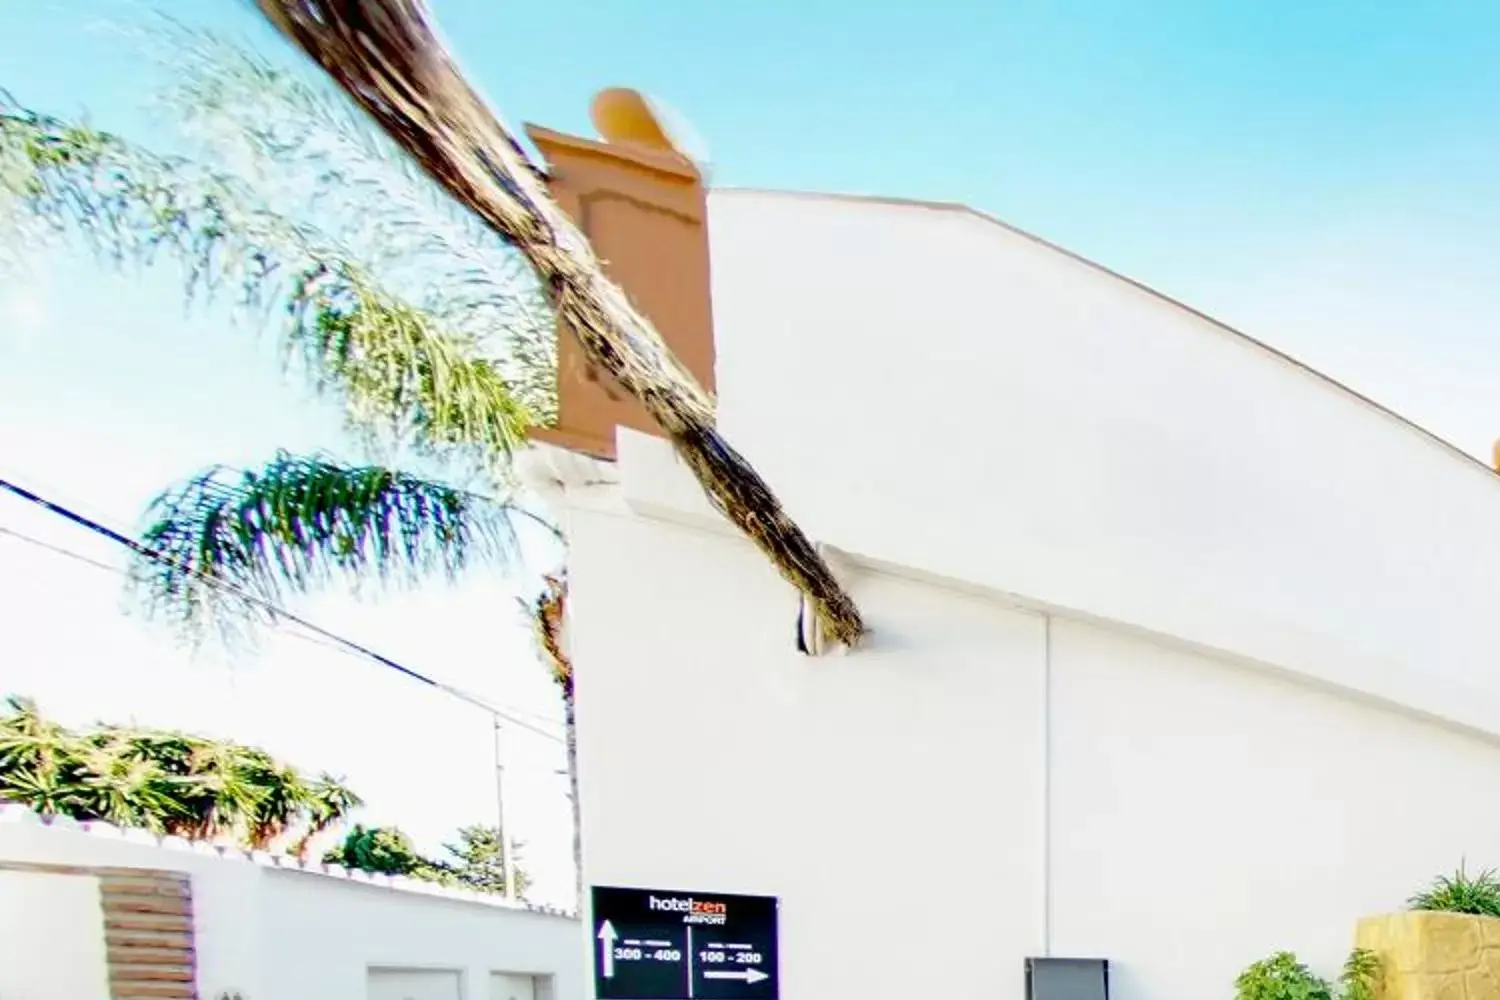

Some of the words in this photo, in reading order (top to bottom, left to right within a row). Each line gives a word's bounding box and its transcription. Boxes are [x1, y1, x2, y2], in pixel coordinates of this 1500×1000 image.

[614, 948, 641, 960] 300
[654, 949, 681, 961] 400
[699, 952, 725, 962] 100
[736, 953, 762, 963] 200
